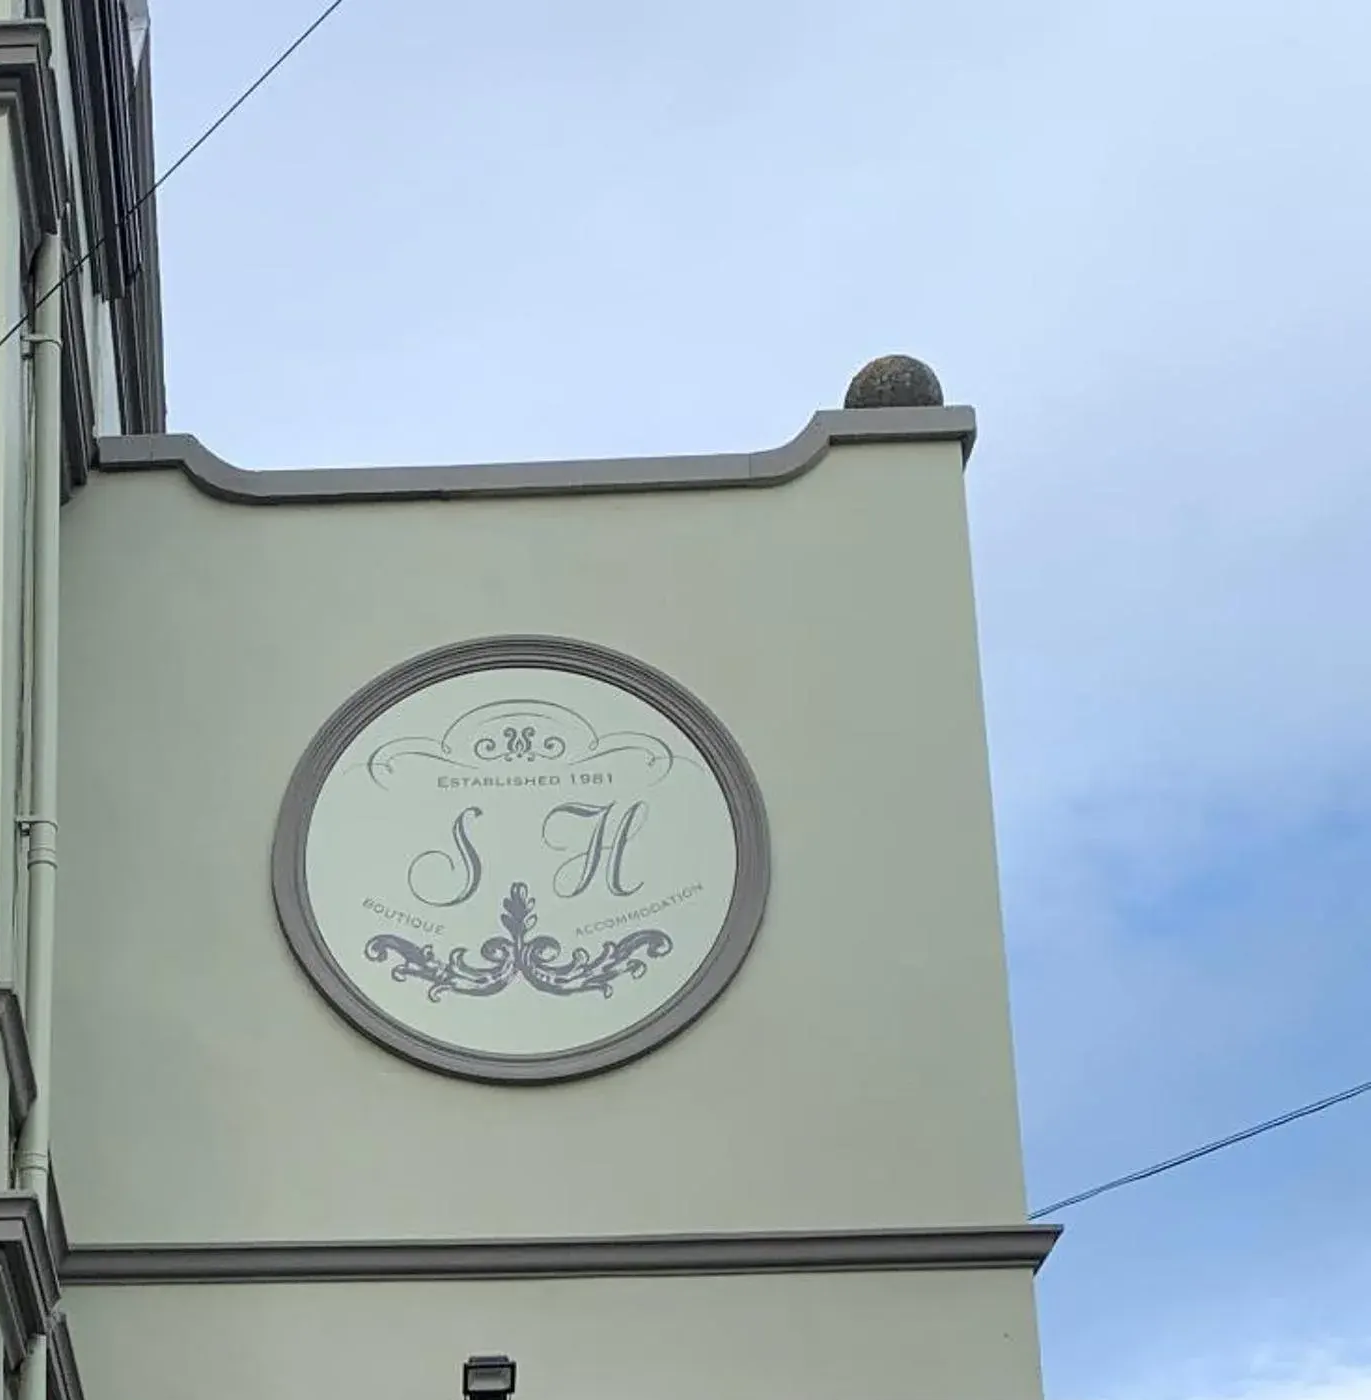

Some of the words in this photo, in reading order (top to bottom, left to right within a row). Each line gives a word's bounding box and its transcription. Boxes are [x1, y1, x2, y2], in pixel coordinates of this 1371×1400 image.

[570, 772, 613, 785] 1981
[407, 806, 483, 908] S
[362, 898, 445, 936] BOUTIQUE
